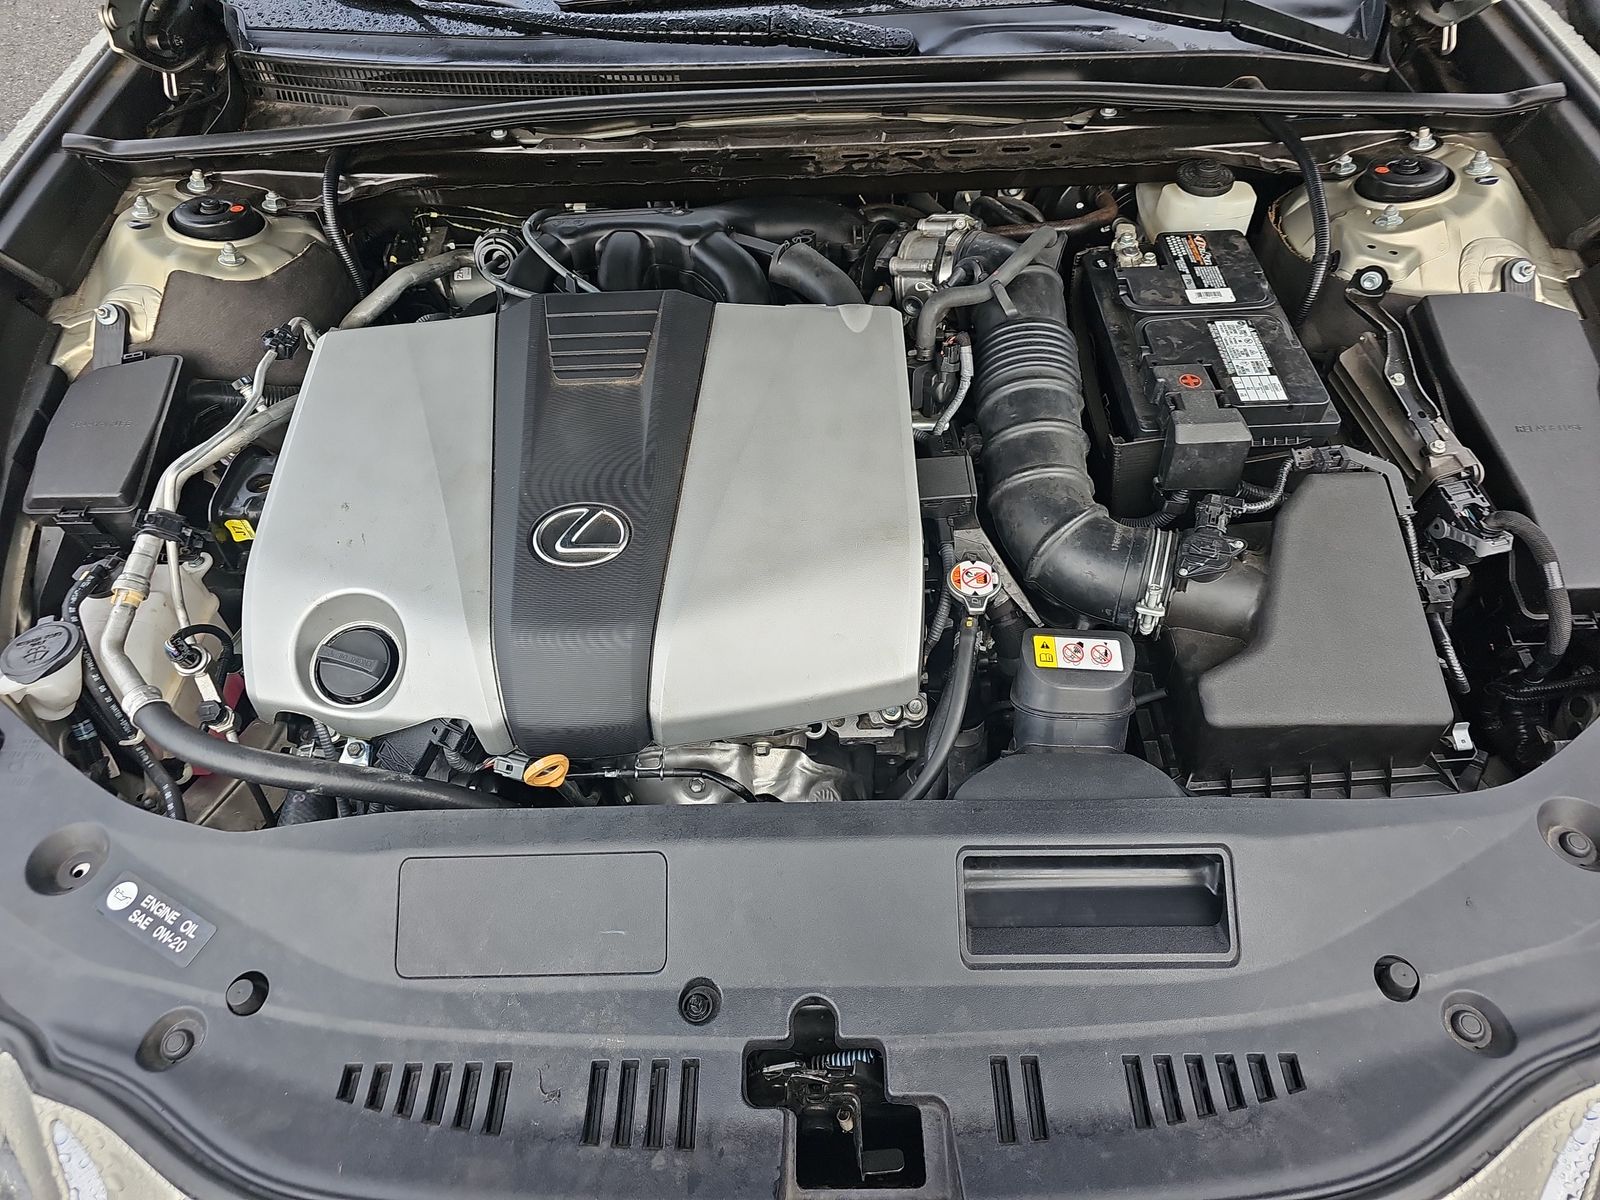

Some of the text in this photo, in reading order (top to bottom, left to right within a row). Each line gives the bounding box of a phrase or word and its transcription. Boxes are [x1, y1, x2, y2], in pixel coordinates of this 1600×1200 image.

[127, 909, 188, 953] SAE 0W-20
[140, 894, 199, 939] ENGINE OIL
